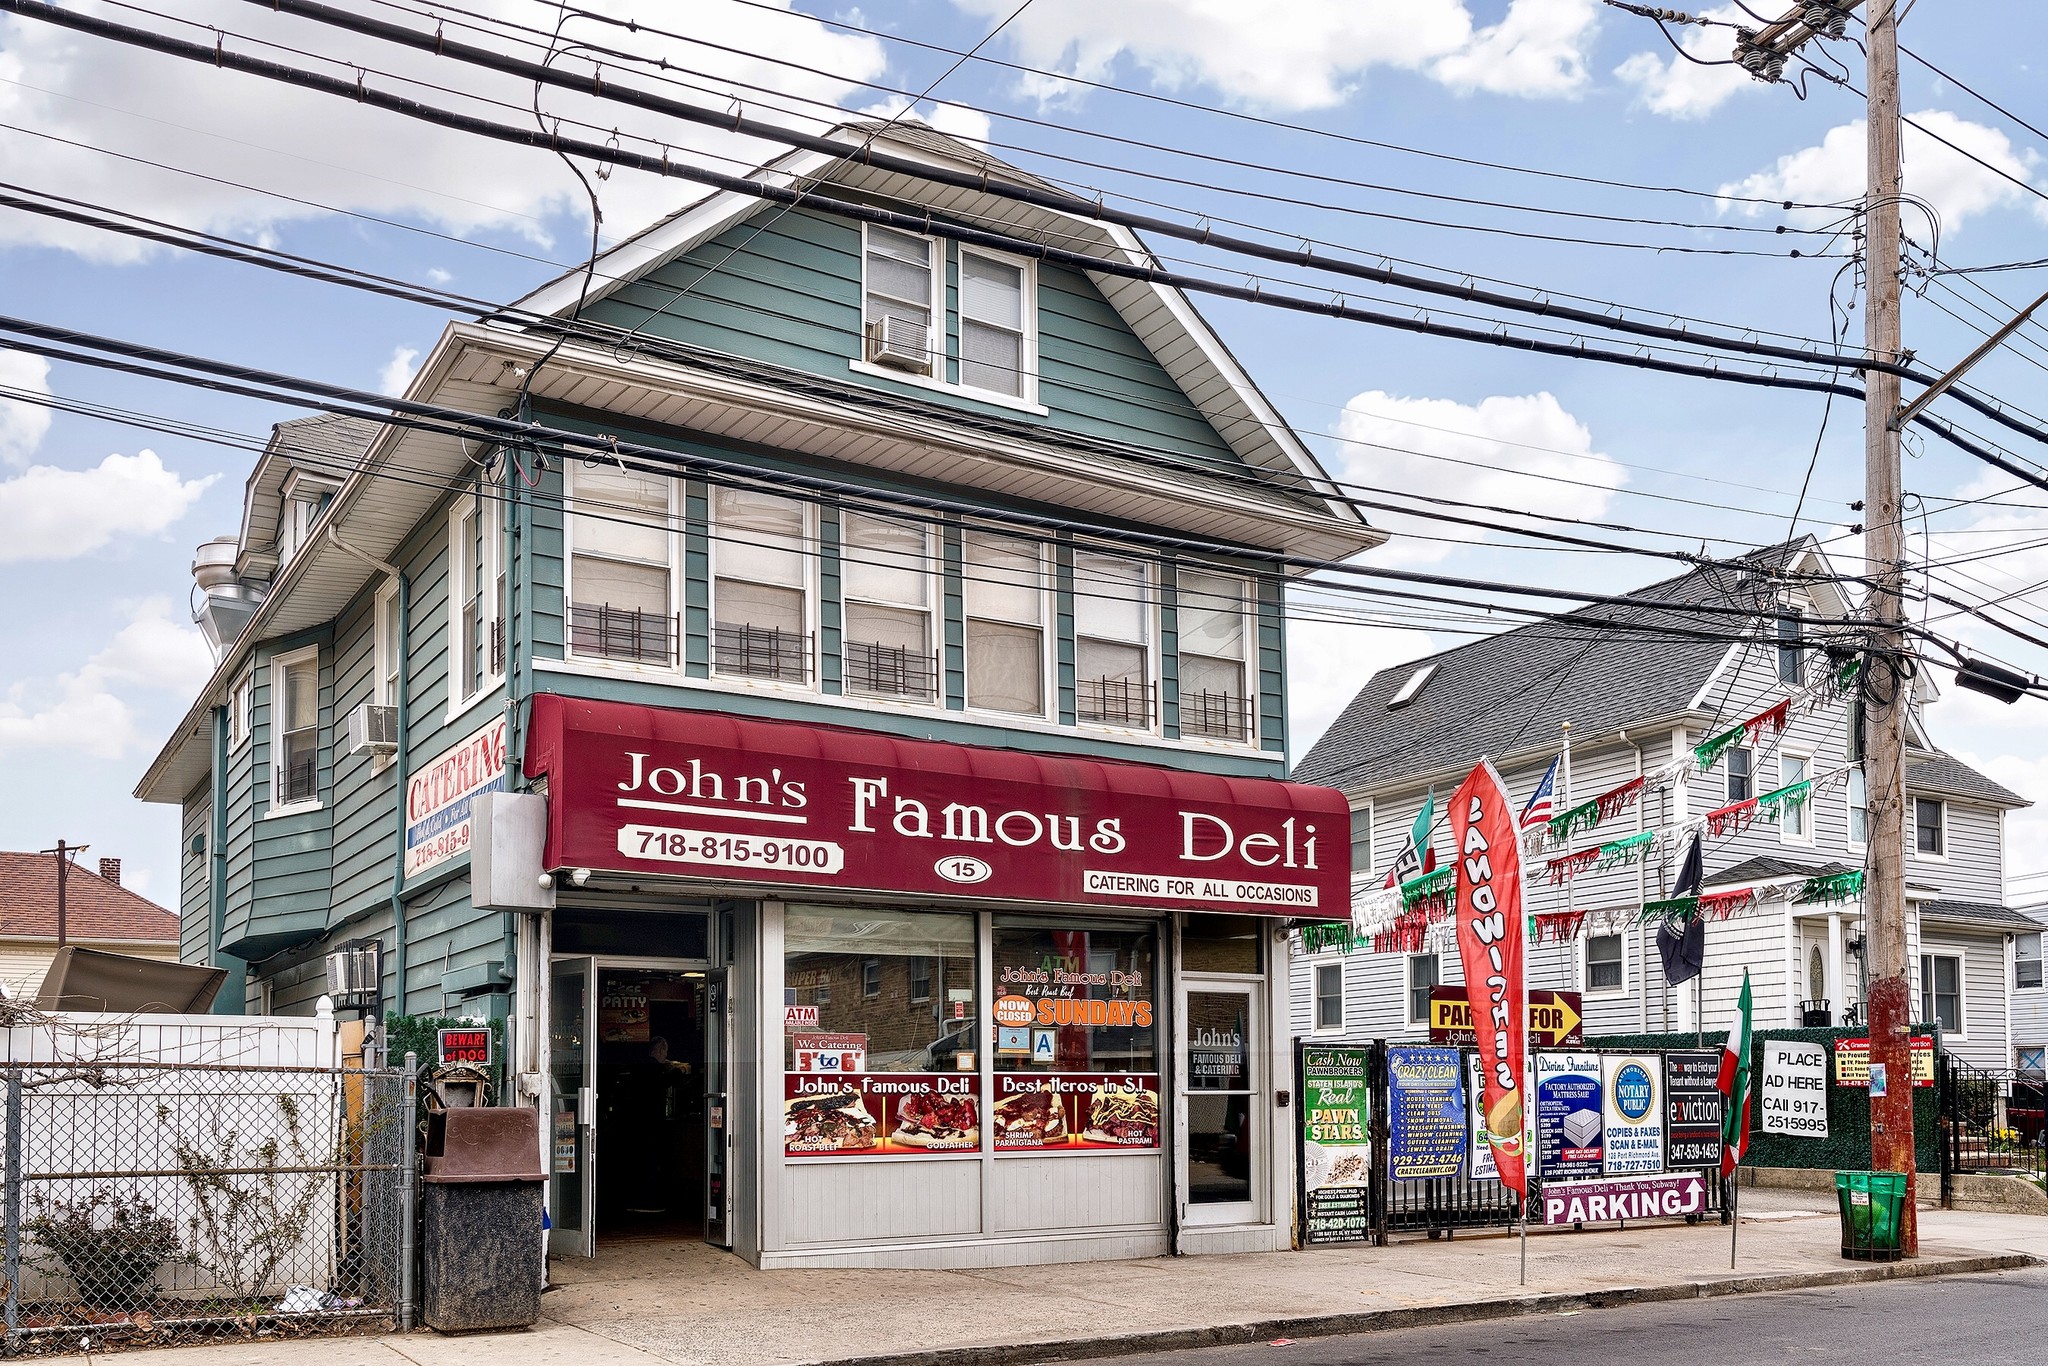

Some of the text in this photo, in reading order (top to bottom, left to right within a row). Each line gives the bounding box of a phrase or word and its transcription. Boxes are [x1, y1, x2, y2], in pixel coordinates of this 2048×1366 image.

[618, 752, 1319, 870] John's Famous Deli
[636, 831, 828, 868] 718-815-9100
[951, 862, 975, 877] 15
[1089, 874, 1312, 903] CATERING FOR ALL OCCASIONS
[1040, 955, 1080, 974] ATM
[1000, 966, 1142, 986] John's Famous Deli
[999, 1001, 1030, 1011] NOW
[1037, 998, 1152, 1027] SUNDAYS
[787, 1008, 815, 1020] ATM
[997, 1011, 1032, 1022] CLOSED
[1529, 1008, 1563, 1029] FOR
[445, 1033, 486, 1047] BEWARE
[1037, 1033, 1051, 1052] A
[1193, 1028, 1240, 1047] John's
[1445, 1030, 1478, 1044] John's
[798, 1040, 863, 1051] We Catering
[446, 1049, 486, 1061] of DOG
[818, 1054, 839, 1067] to
[1193, 1054, 1241, 1064] FAMOUS DELI
[1307, 1052, 1362, 1066] Cash Now
[1778, 1052, 1822, 1066] PLACE
[1195, 1065, 1239, 1074] & CATERING
[1539, 1056, 1598, 1071] Divine Furniture
[1669, 1061, 1677, 1072] The
[1684, 1064, 1692, 1074] way
[1693, 1062, 1697, 1072] to
[1698, 1061, 1708, 1072] Evict
[1708, 1064, 1717, 1074] your
[1307, 1067, 1363, 1076] PAWNBROKERS
[1398, 1065, 1456, 1079] CRAZY CLEAN
[1618, 1067, 1649, 1083] AUTHORIZED
[794, 1076, 970, 1094] John's Famous Deli
[1003, 1077, 1146, 1093] Best Heros in S.I.
[1308, 1080, 1363, 1089] STATEN ISLAND'S
[1669, 1075, 1684, 1086] Tenant
[1684, 1075, 1700, 1086] without
[1703, 1076, 1717, 1088] Lawye
[1765, 1074, 1823, 1090] AD HERE
[1318, 1088, 1354, 1106] Real
[1618, 1085, 1649, 1098] NOTARY
[1623, 1099, 1646, 1110] PUBLIC
[1670, 1096, 1719, 1121] ezviction
[1793, 1100, 1824, 1113] 917-
[1311, 1109, 1359, 1124] PAWN
[1006, 1131, 1034, 1139] SHRIMP
[1312, 1125, 1363, 1140] STARS
[1607, 1127, 1633, 1138] COPIES
[1634, 1127, 1639, 1137] &
[1640, 1127, 1660, 1137] FAXES
[789, 1143, 838, 1152] ROAST BEEF
[926, 1141, 974, 1149] GODFATHER
[995, 1139, 1043, 1147] PARMIGIANA
[1118, 1137, 1152, 1145] PASTRAMI
[1610, 1139, 1659, 1150] SCAN & E-MAIL
[1628, 1151, 1650, 1159] Richmond
[1670, 1143, 1719, 1160] 347-539-1435
[1397, 1166, 1457, 1175] CRAZYCLEANNYC.COM
[1608, 1160, 1660, 1170] 718-727-7510
[1548, 1179, 1679, 1195] John's Famous Deli Thank You, Subway!
[1547, 1190, 1682, 1224] PARKING
[1309, 1217, 1366, 1230] 718-420-1078
